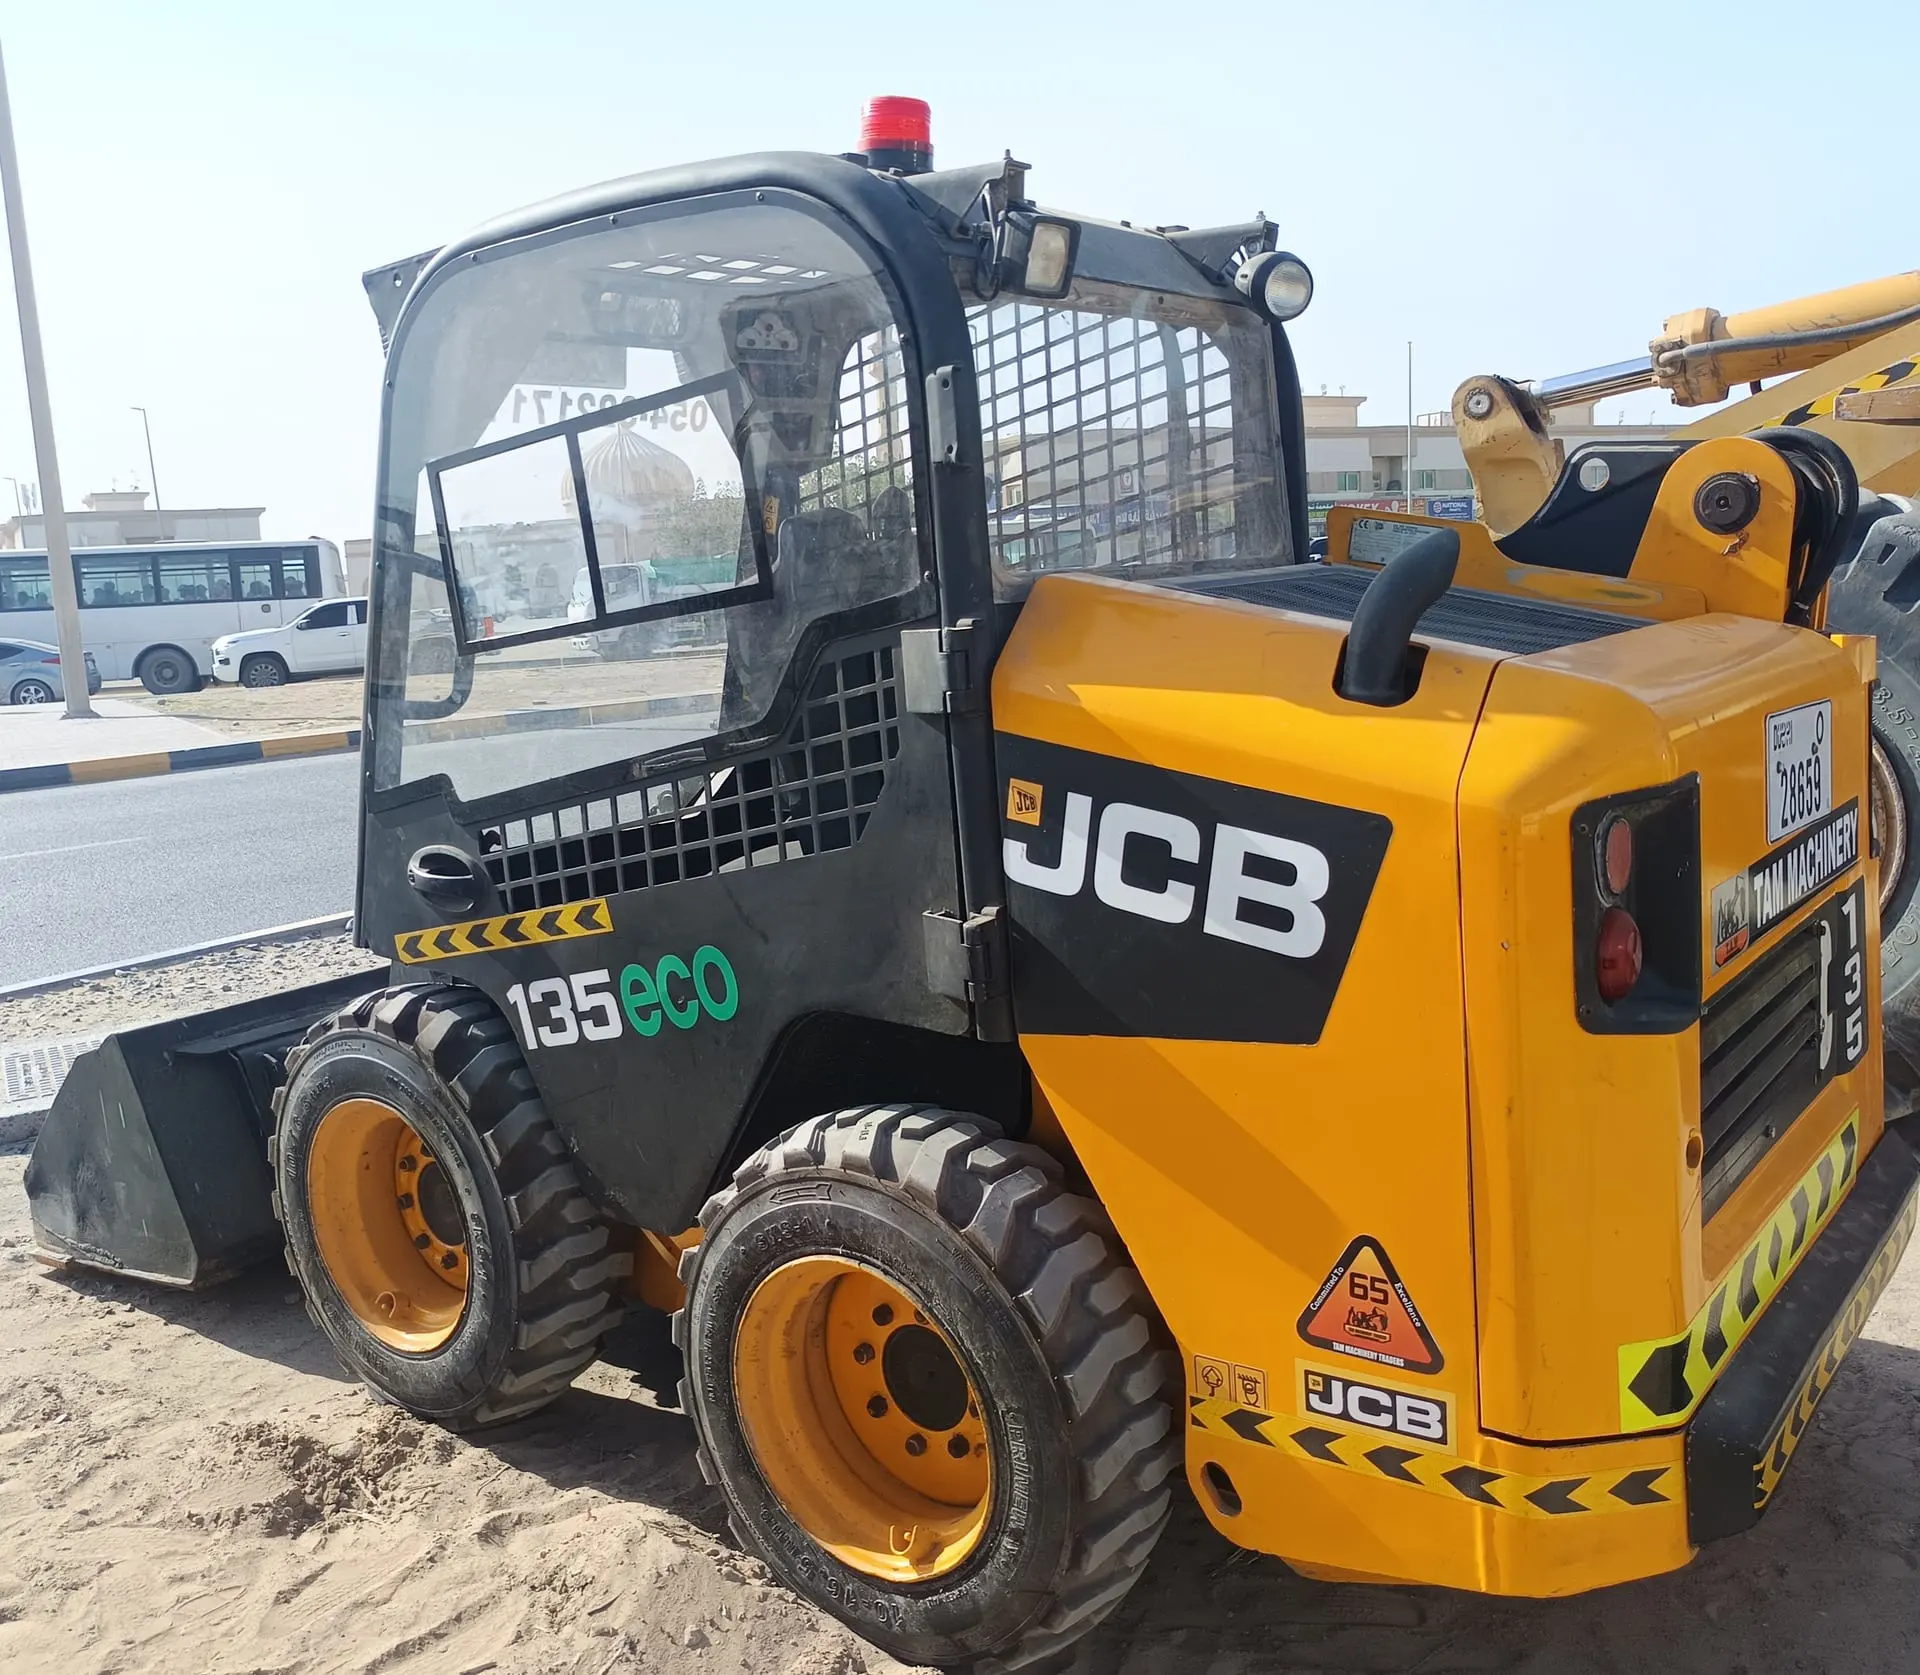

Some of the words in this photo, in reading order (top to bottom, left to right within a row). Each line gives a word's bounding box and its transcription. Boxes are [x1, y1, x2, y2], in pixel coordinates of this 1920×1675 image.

[1016, 790, 1036, 812] JCB
[1780, 754, 1822, 828] 28659
[1003, 791, 1330, 959] JCB
[1754, 858, 1783, 929] TAM
[1787, 808, 1858, 905] MACHINERY
[1310, 1273, 1338, 1311] Committed
[1334, 1266, 1345, 1277] To
[1350, 1271, 1389, 1306] 65
[1394, 1282, 1421, 1328] Excellence
[1332, 1342, 1344, 1352] TAM
[1345, 1344, 1378, 1361] MACHINERY
[1378, 1352, 1405, 1367] TRADERS
[1308, 1379, 1444, 1440] JCB
